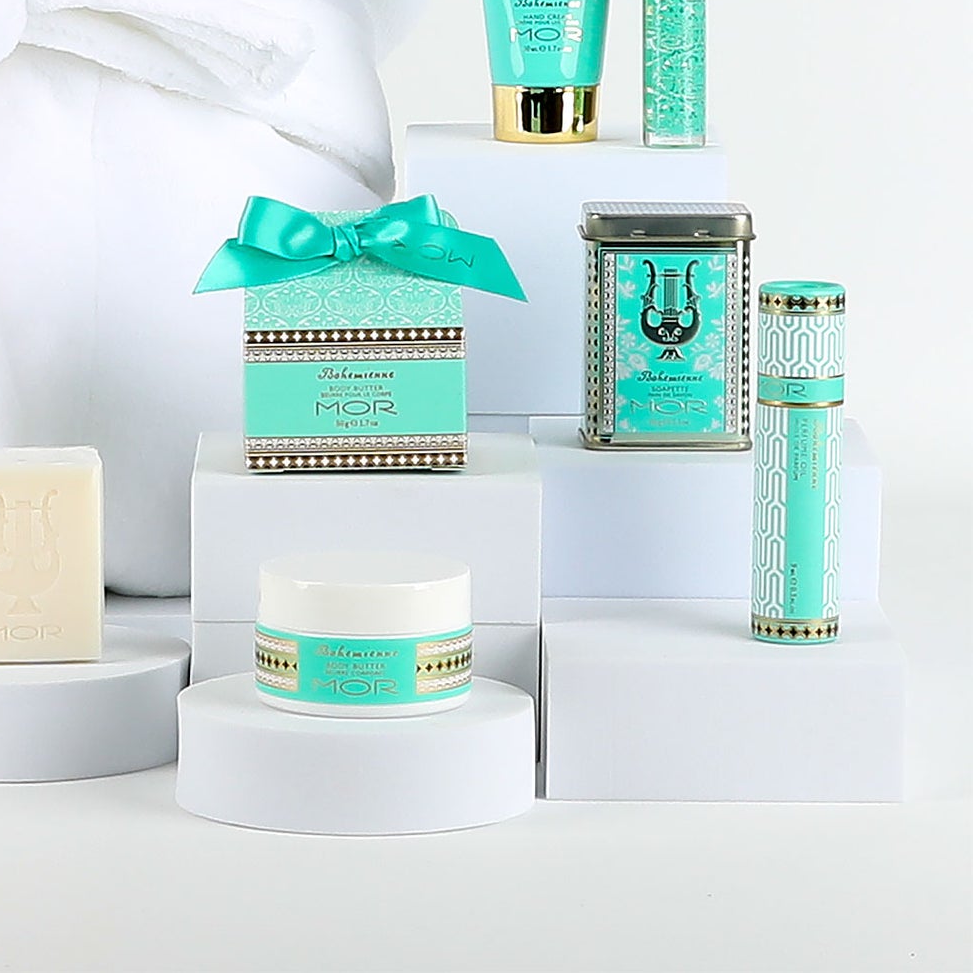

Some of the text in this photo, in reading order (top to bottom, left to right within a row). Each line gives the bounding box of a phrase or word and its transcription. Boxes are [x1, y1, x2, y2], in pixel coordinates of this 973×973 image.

[510, 27, 583, 43] MOR
[317, 367, 395, 380] Bohemienne
[637, 370, 704, 382] Bohemienne
[651, 385, 689, 393] SOAPETTE
[761, 381, 808, 398] OR
[315, 400, 398, 416] MOR
[630, 399, 709, 416] MOR
[800, 418, 808, 457] PERFUME
[315, 644, 399, 657] Bohemienne
[311, 678, 400, 696] MOR
